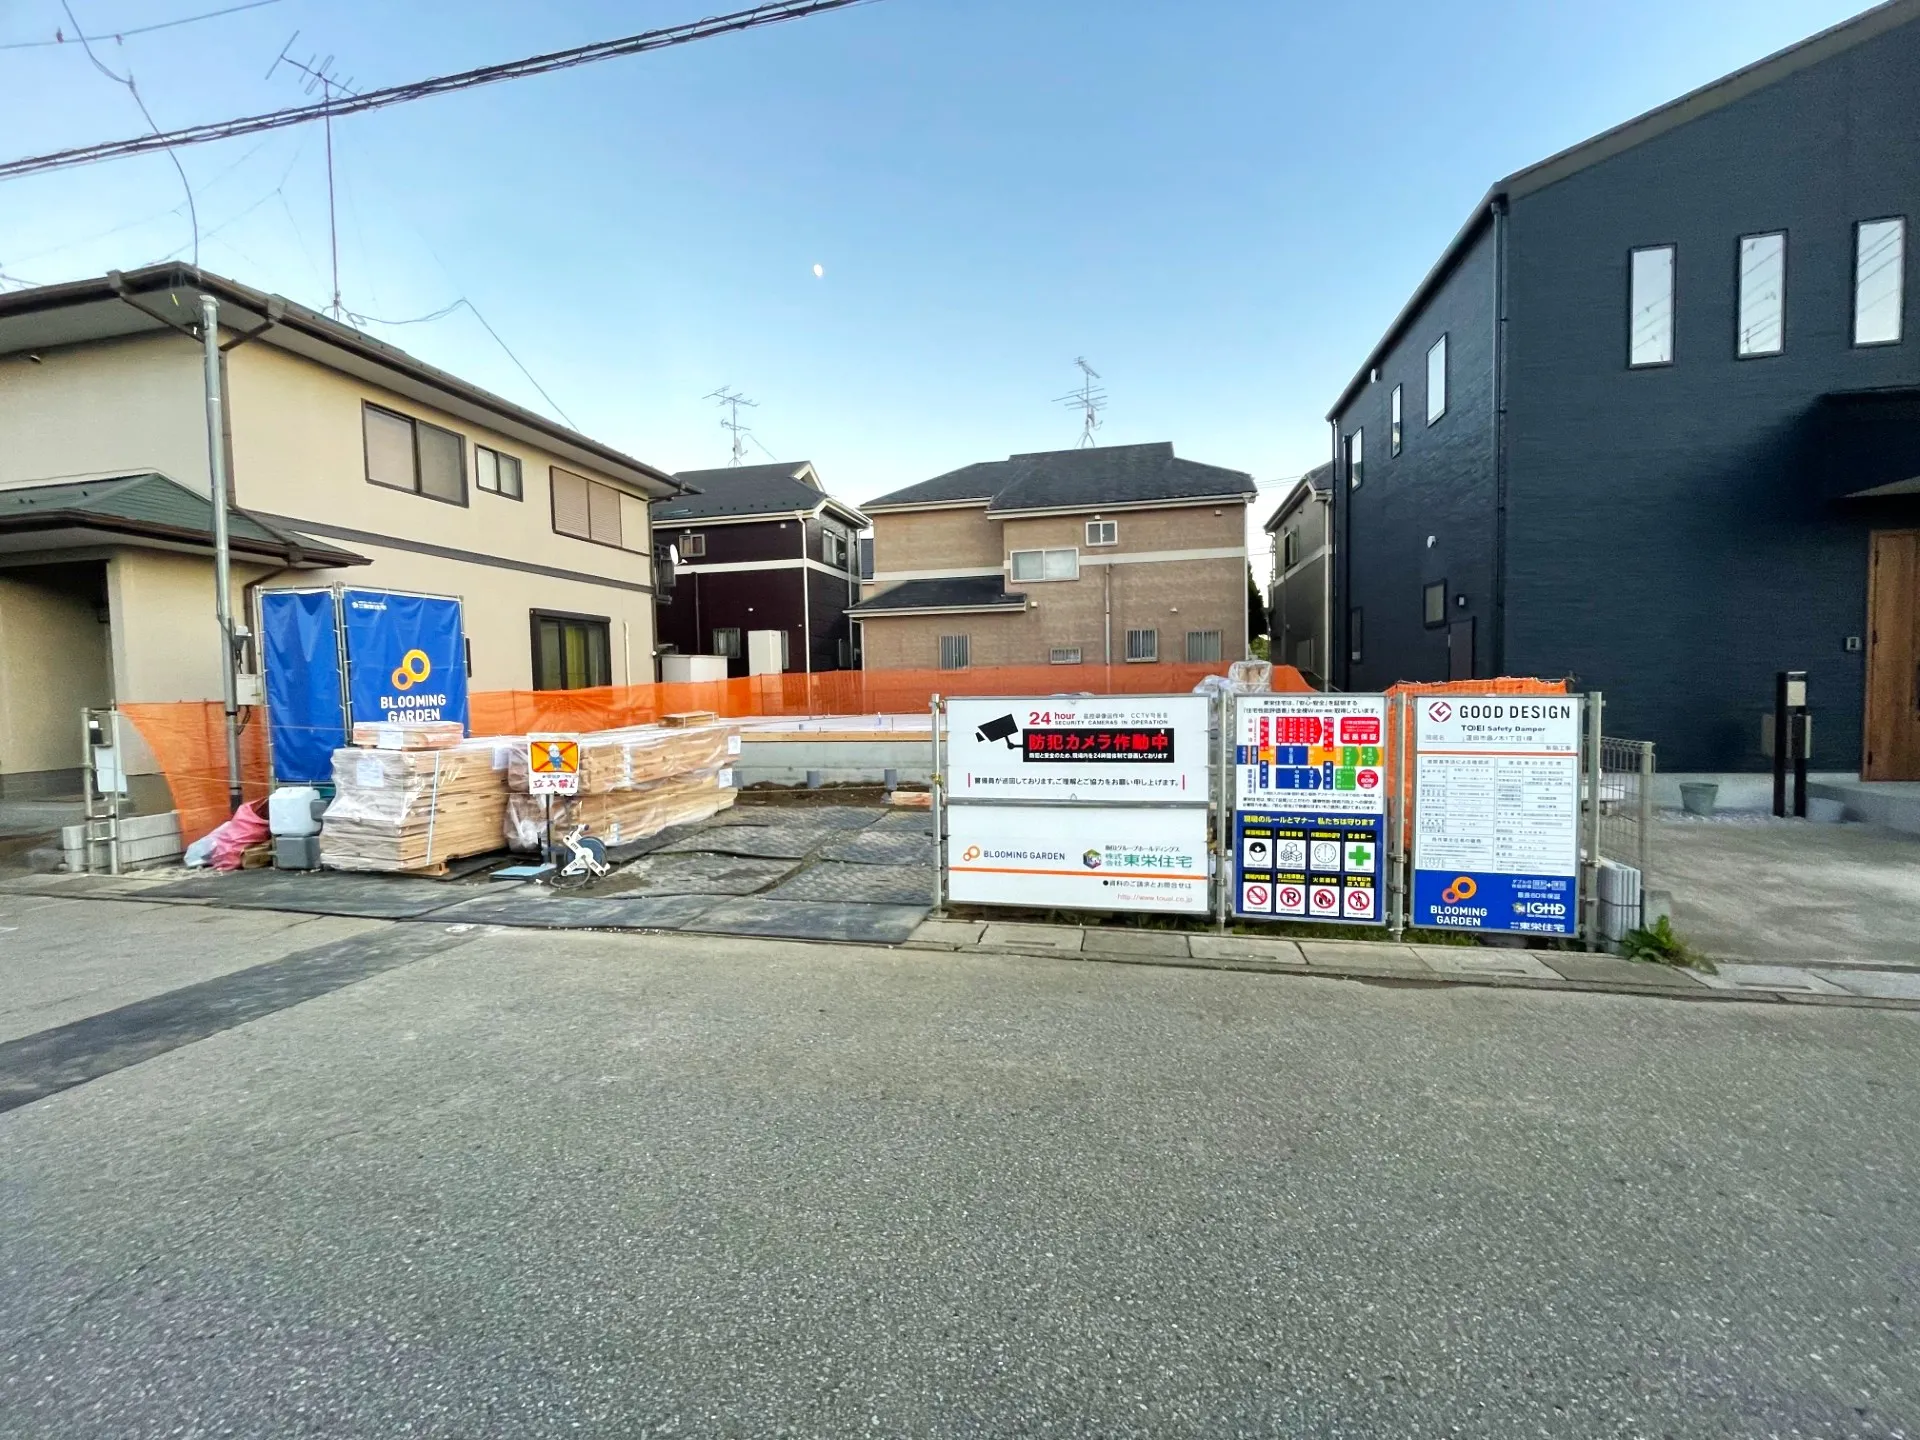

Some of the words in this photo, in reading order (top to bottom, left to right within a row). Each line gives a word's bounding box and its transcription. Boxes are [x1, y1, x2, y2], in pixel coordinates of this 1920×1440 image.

[381, 694, 446, 709] BLOOMING
[388, 708, 440, 722] GARDEN
[1029, 711, 1051, 725] 24
[1459, 705, 1504, 719] GOOD
[1509, 705, 1570, 719] DESIGN
[1487, 725, 1512, 733] Safety
[1515, 725, 1546, 733] Damper
[1028, 733, 1169, 751] 防犯カメラ作動中
[1317, 816, 1376, 826] 私たちは守ります
[983, 850, 1028, 859] BLOOMING
[1030, 851, 1066, 860] GARDEN
[1123, 853, 1193, 869] 東栄住宅
[1430, 905, 1488, 917] BLOOMING
[1436, 915, 1481, 926] GARDEN
[1519, 922, 1566, 933] 東栄住宅
